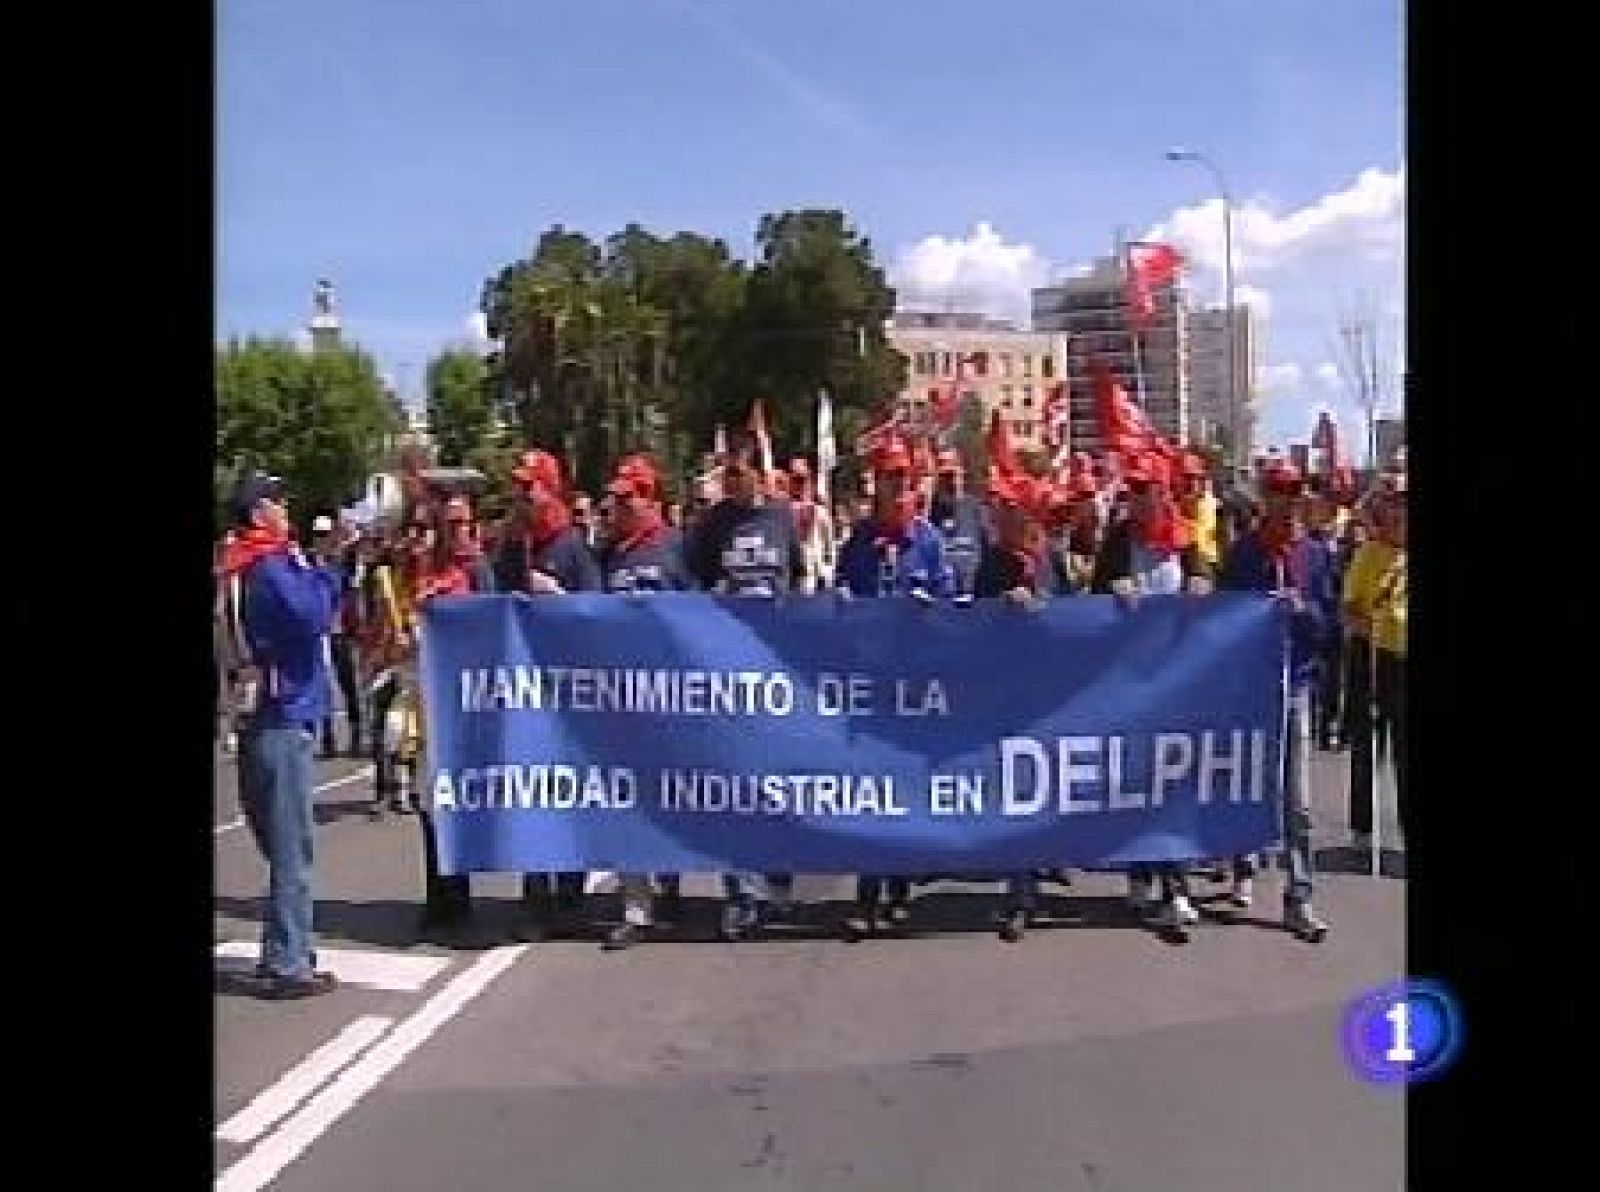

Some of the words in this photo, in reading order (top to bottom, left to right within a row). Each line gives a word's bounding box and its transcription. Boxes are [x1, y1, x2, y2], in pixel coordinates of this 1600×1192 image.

[461, 667, 794, 715] MANTENIMIENTO
[817, 672, 874, 716] DE
[896, 677, 950, 715] LA
[433, 765, 637, 811] ACTIVIDAD
[661, 769, 909, 816] INDUSTRIAL
[930, 774, 983, 815] EN
[1001, 729, 1266, 816] DELPHI
